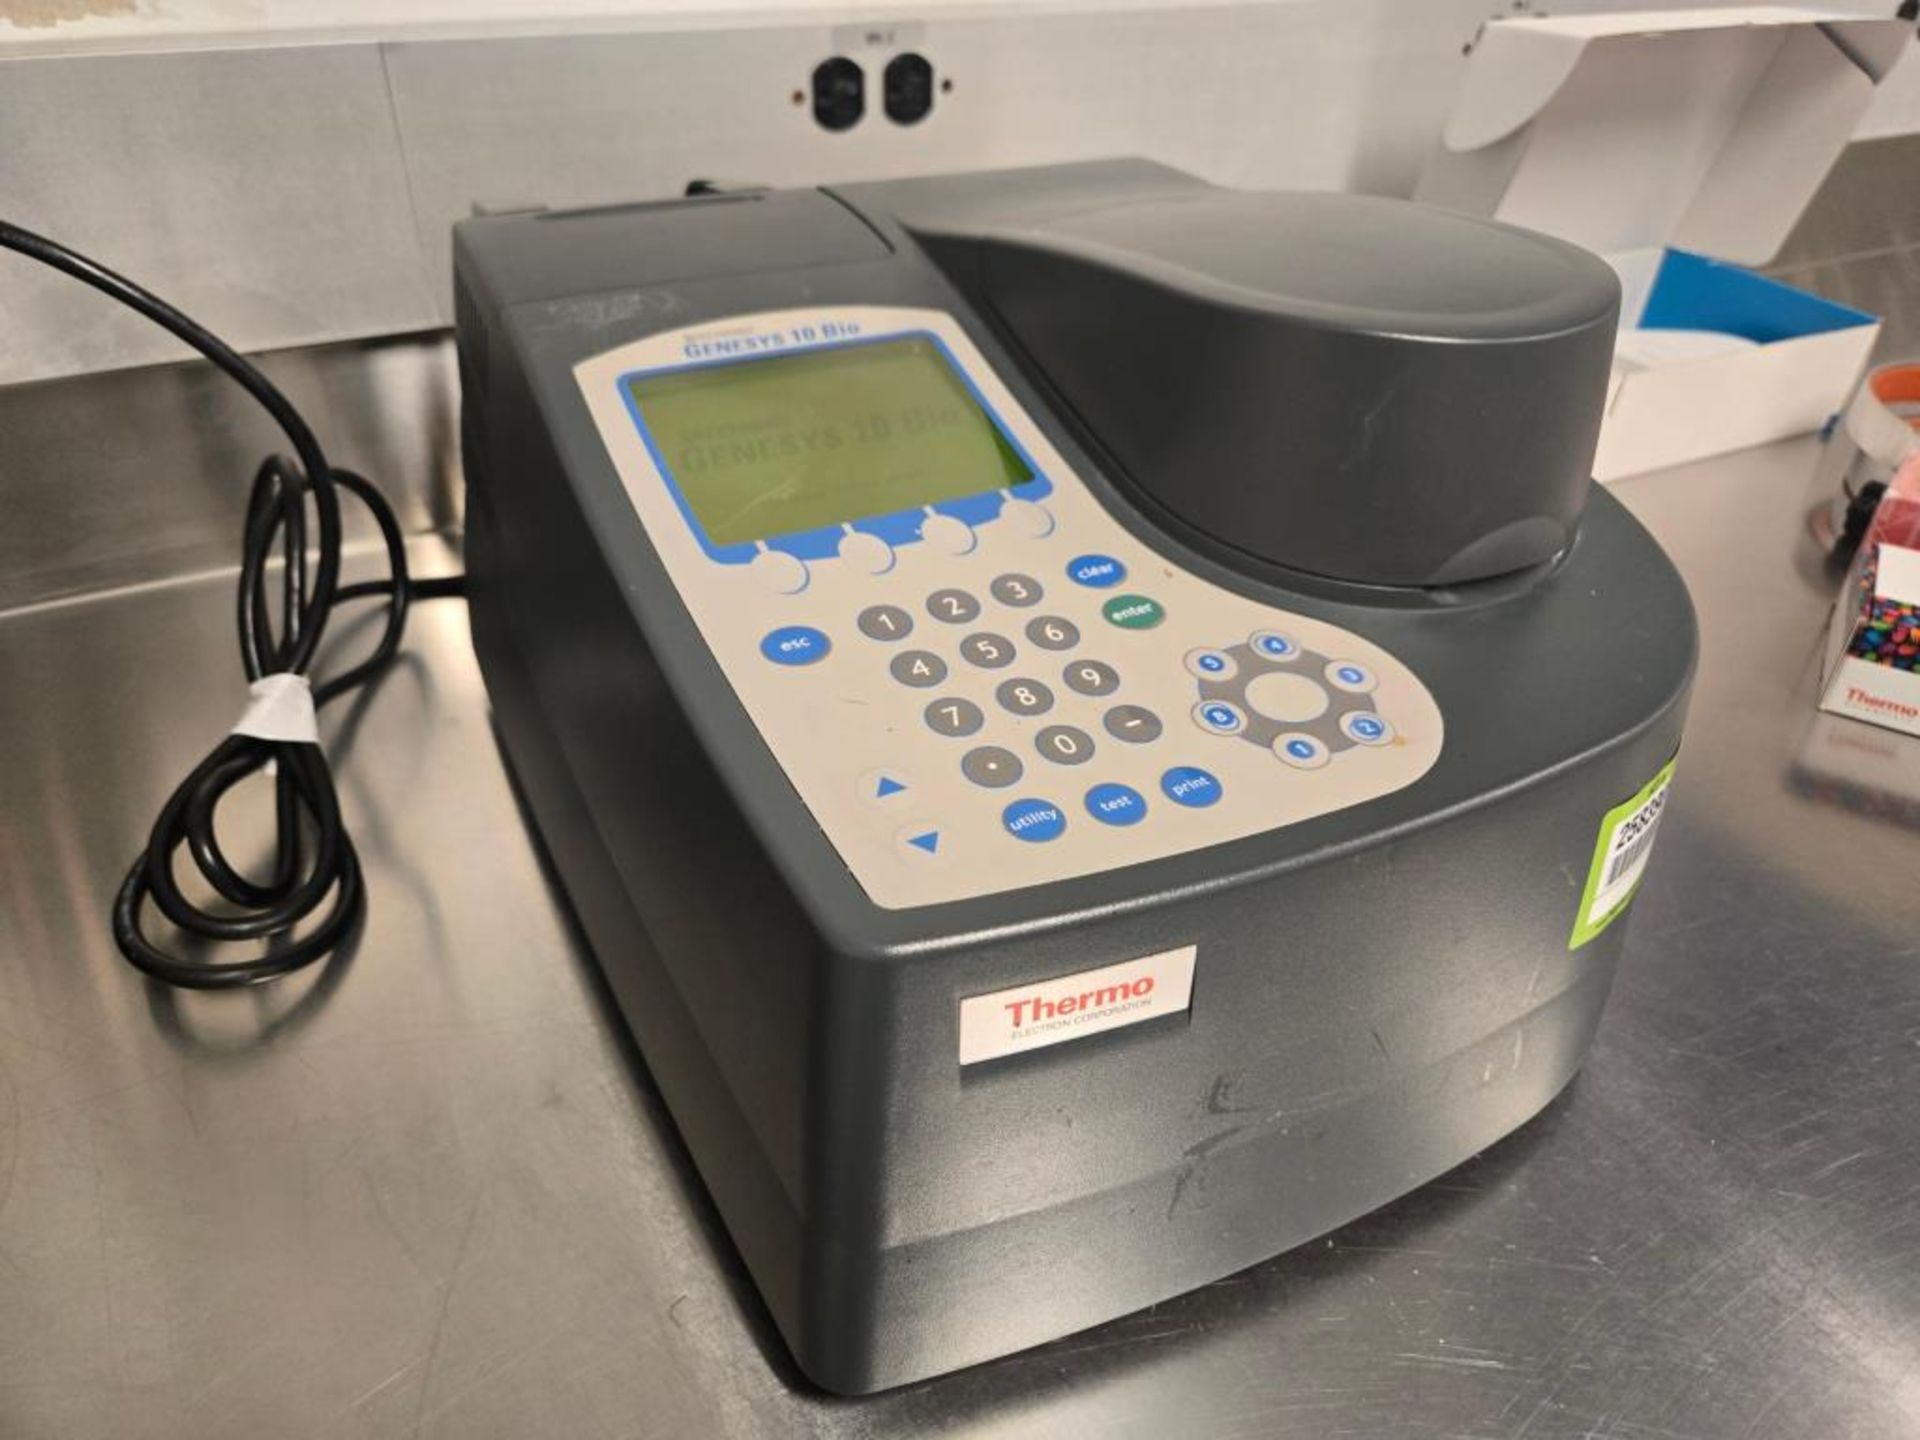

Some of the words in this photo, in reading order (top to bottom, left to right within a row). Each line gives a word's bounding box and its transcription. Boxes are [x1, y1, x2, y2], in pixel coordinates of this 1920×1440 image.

[684, 331, 786, 358] GENESYS
[792, 325, 816, 343] 10
[821, 321, 861, 339] Bio
[1076, 563, 1114, 580] clear
[878, 612, 896, 632] 1
[943, 597, 967, 617] 2
[1008, 580, 1029, 600] 3
[1111, 602, 1153, 621] enter
[779, 634, 811, 653] esc
[911, 658, 932, 677] 4
[976, 640, 1000, 660] 5
[1043, 623, 1066, 643] 6
[940, 705, 961, 728] 7
[1014, 685, 1037, 706] 8
[1079, 667, 1102, 687] 9
[1847, 687, 1920, 717] Thermo
[1052, 733, 1077, 755] 0
[1009, 808, 1058, 832] utility
[1100, 795, 1133, 812] test
[1171, 775, 1211, 798] print
[1004, 975, 1155, 1029] Thermo
[1011, 1017, 1073, 1041] ELECTRON
[1073, 999, 1154, 1026] CORPORATION
